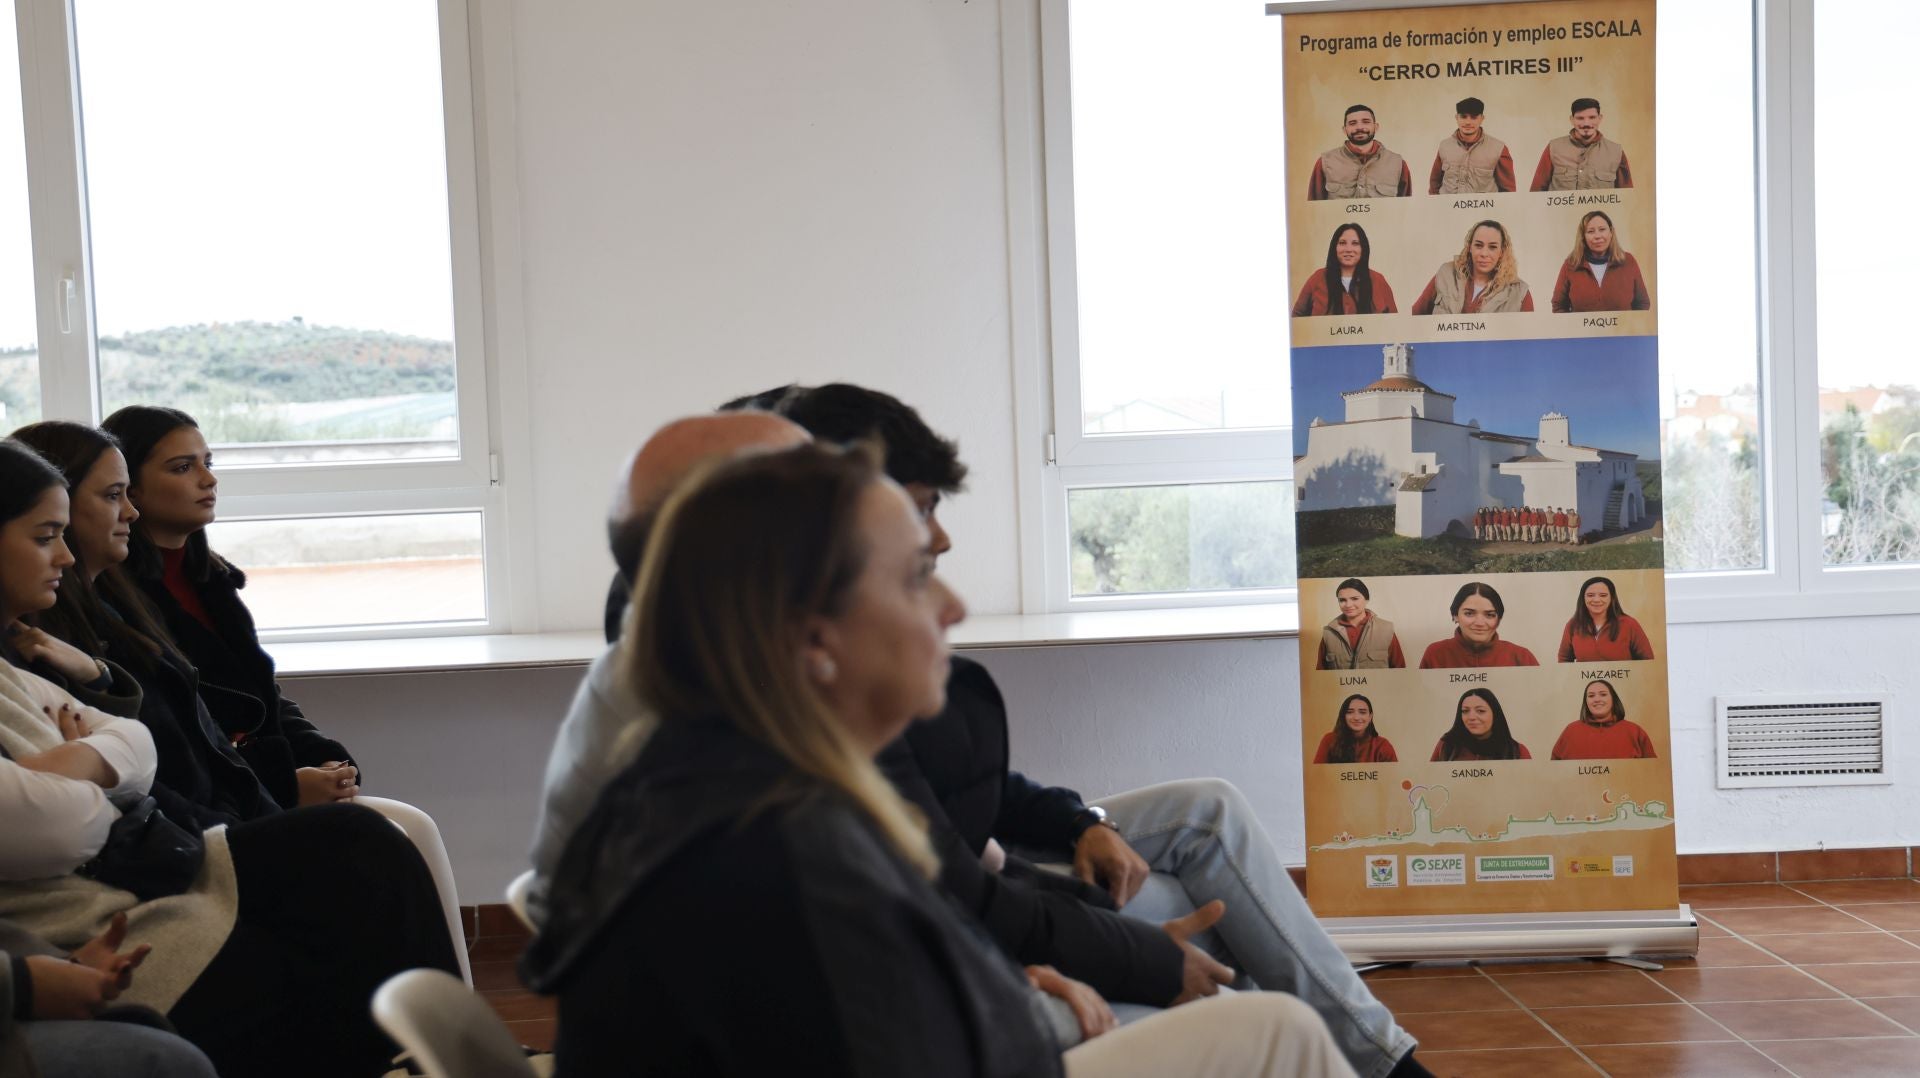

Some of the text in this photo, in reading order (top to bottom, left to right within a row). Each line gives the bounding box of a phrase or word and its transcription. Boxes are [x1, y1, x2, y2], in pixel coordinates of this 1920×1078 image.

[1300, 19, 1642, 55] Programa de formación y empleo ESCALA
[1359, 56, 1584, 81] “CERRO MÁRTIRES III”
[1453, 199, 1494, 209] ADRIAN
[1546, 193, 1621, 206] JOSÉ MANUEL
[1345, 204, 1371, 214] CRIS
[1437, 321, 1486, 332] MARTINA
[1583, 317, 1618, 328] PAQUI
[1330, 325, 1364, 336] LAURA
[1449, 672, 1488, 683] IRACHE
[1581, 669, 1631, 680] NAZARET
[1339, 676, 1368, 686] LUNA
[1340, 770, 1379, 781] SELENE
[1451, 768, 1494, 778] SANDRA
[1578, 765, 1610, 775] LUCIA
[1428, 858, 1462, 871] SEXPE
[1483, 858, 1547, 869] JUNTA DE EXTREMADURA
[1615, 866, 1631, 874] SEPE
